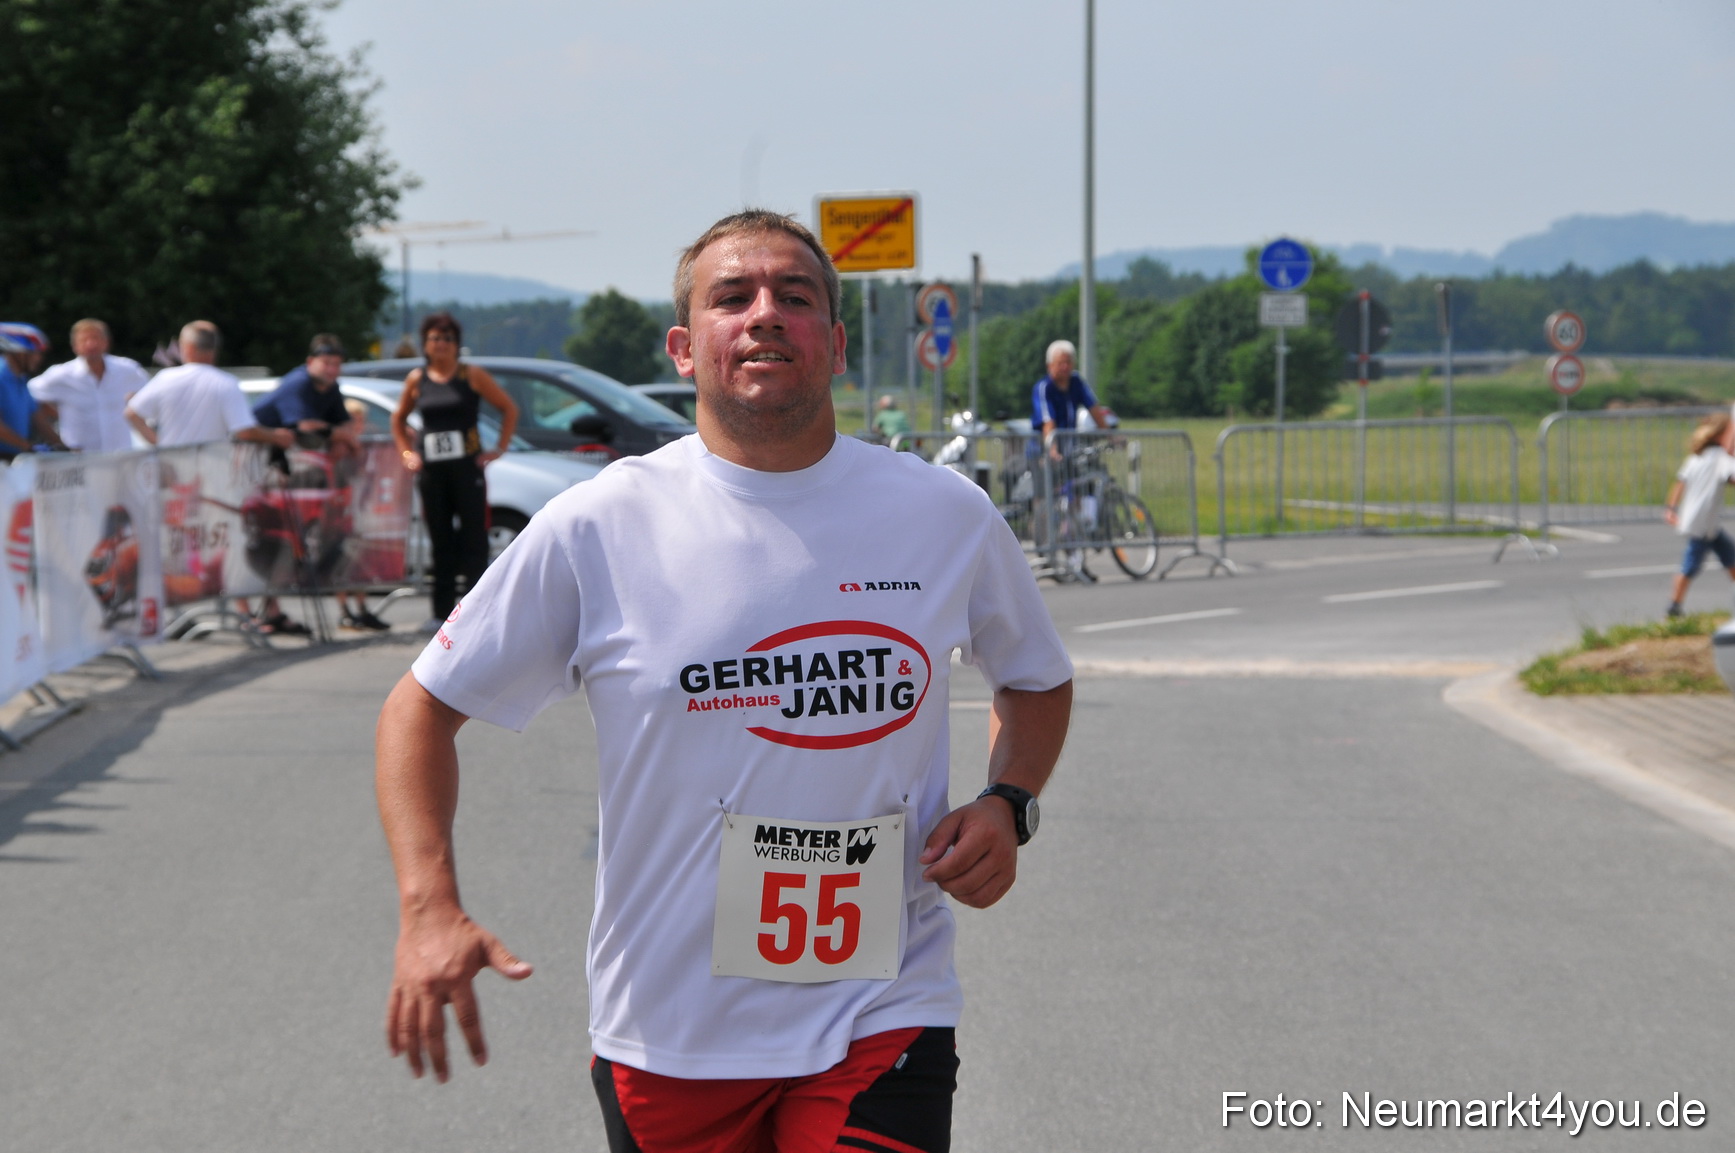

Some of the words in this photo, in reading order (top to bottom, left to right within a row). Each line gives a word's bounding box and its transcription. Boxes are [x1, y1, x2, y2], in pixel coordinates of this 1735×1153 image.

[864, 581, 922, 591] ADRIA
[679, 647, 892, 694] GERHART
[897, 659, 913, 676] &
[687, 694, 781, 713] Autohaus
[781, 681, 915, 719] JÄNIG
[754, 824, 841, 848] MEYER
[754, 844, 841, 863] WERBUNG
[757, 871, 861, 965] 55
